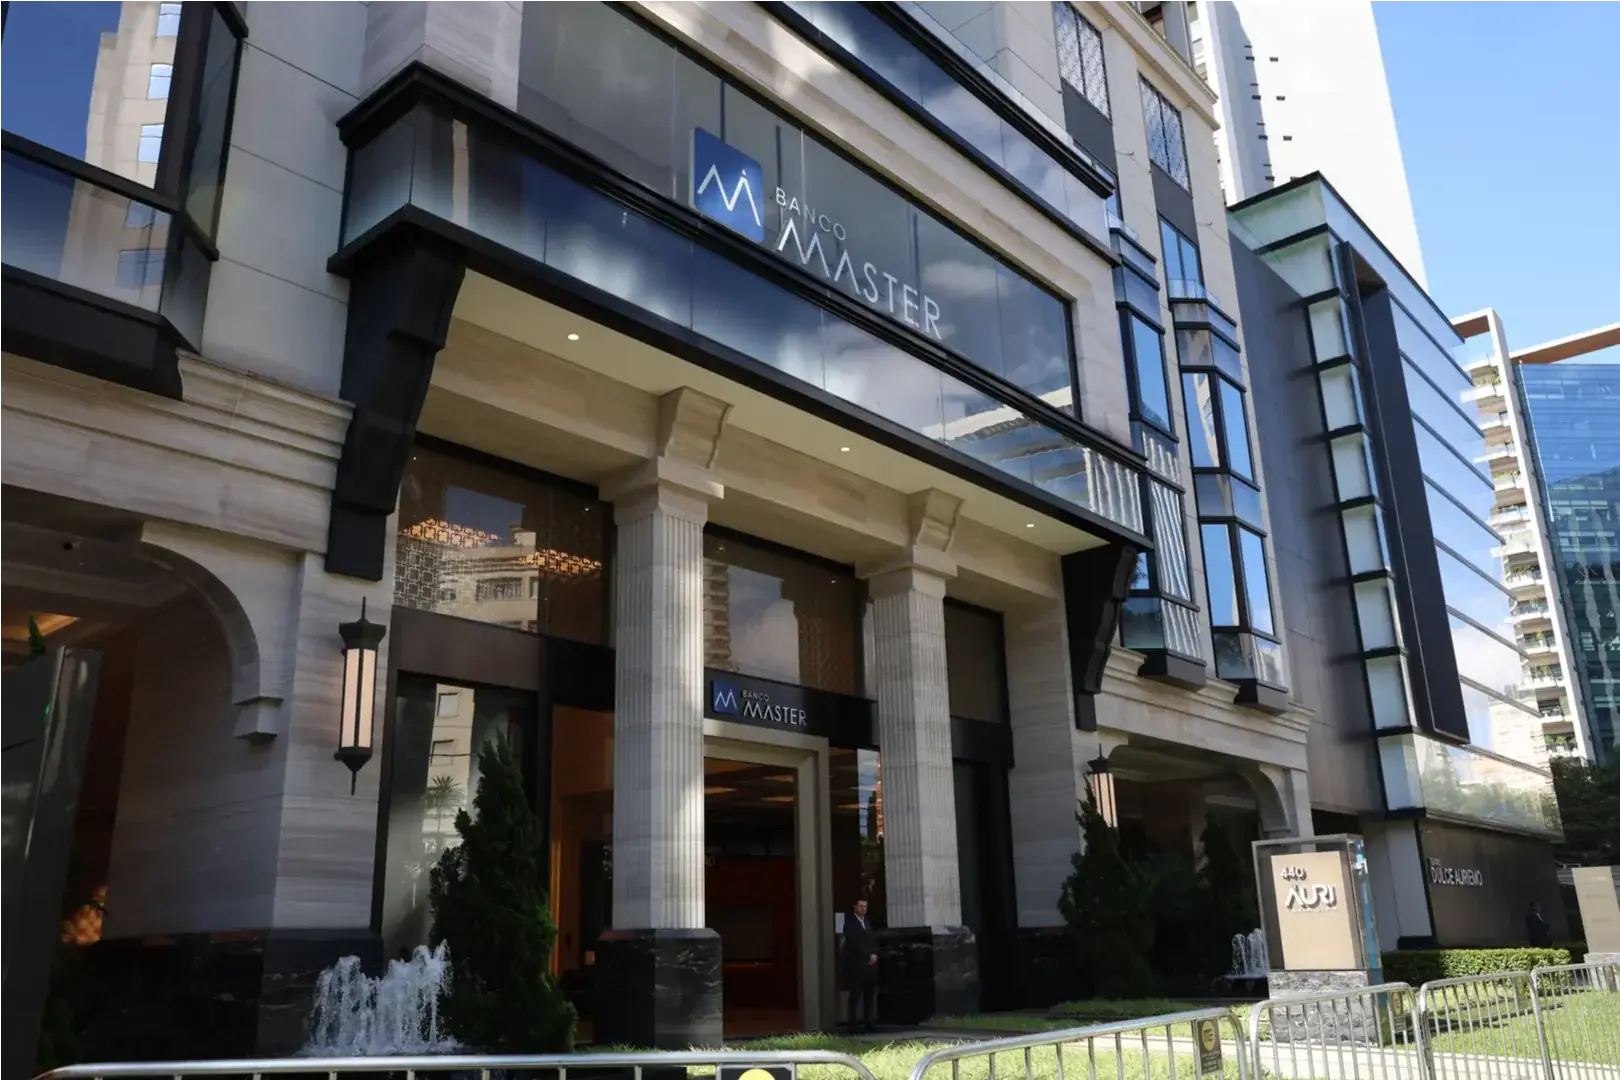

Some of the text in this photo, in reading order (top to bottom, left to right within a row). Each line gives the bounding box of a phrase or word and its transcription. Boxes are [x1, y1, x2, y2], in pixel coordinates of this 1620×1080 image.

[775, 186, 847, 241] BANCO
[777, 217, 942, 341] MASTER
[742, 689, 770, 702] BANCO
[743, 700, 807, 726] MASTER
[1281, 867, 1306, 880] 440
